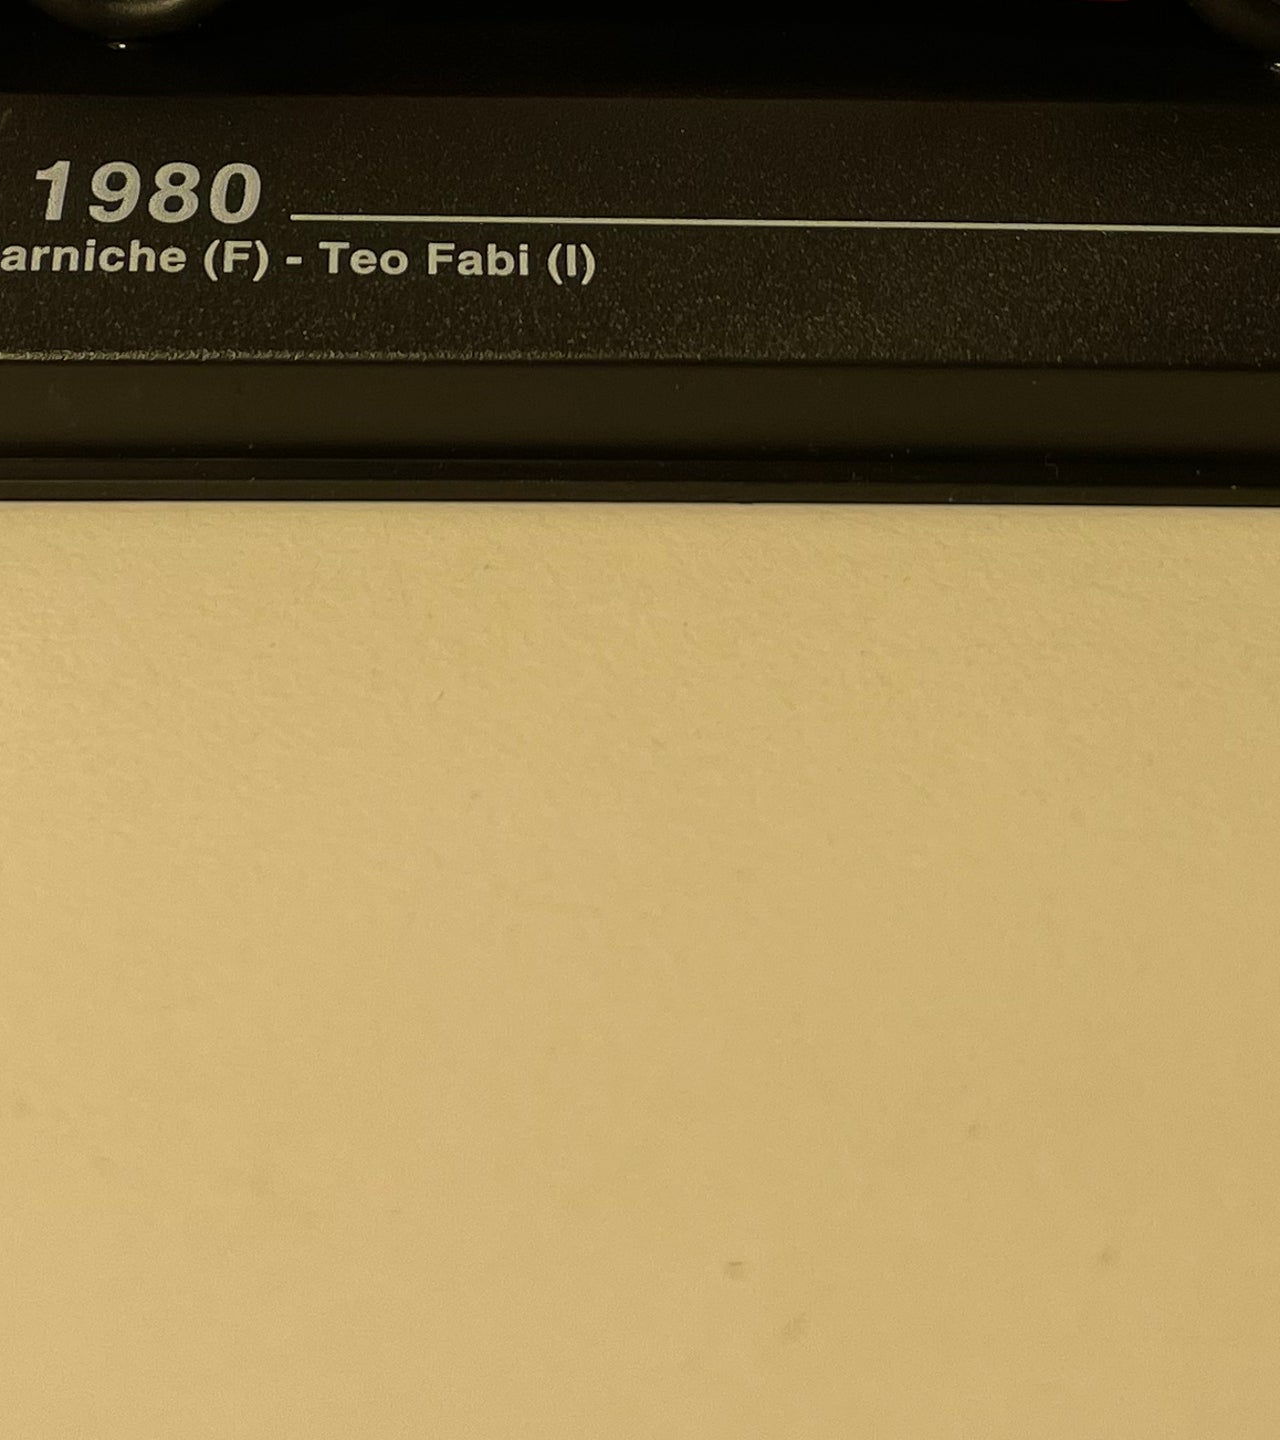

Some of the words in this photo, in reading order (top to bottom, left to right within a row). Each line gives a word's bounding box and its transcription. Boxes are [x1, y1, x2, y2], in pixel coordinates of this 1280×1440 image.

[35, 160, 261, 224] 1980
[204, 239, 269, 282] (F)
[286, 255, 302, 265] -
[318, 241, 409, 275] Teo
[428, 242, 529, 276] Fabi
[547, 243, 596, 286] (I)
